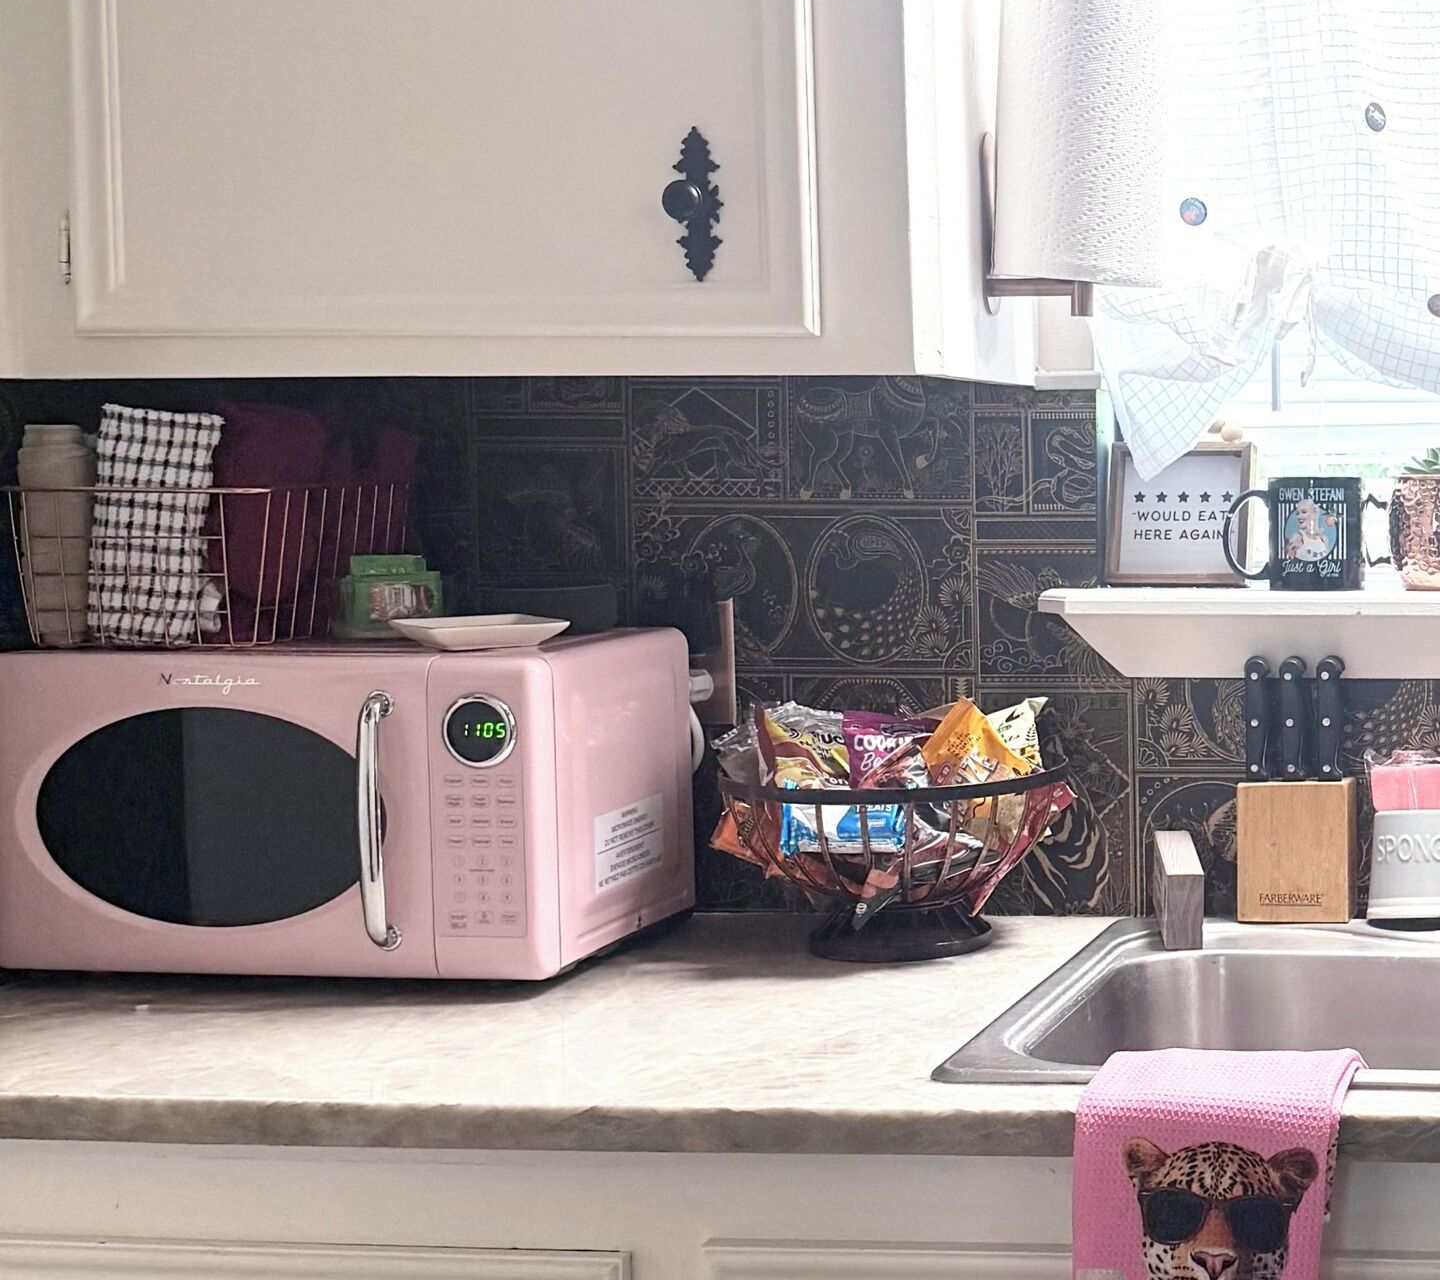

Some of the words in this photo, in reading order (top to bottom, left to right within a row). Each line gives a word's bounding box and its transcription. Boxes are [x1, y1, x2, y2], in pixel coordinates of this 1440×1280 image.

[1279, 487, 1304, 501] GWEN
[1308, 487, 1345, 501] STEFANI
[1198, 510, 1230, 522] EAT
[1133, 529, 1173, 541] HERE
[1281, 559, 1305, 577] Just
[1306, 563, 1315, 573] a
[1317, 559, 1342, 578] Girl
[856, 804, 893, 814] TEATS
[1259, 893, 1323, 904] FARBERWARE
